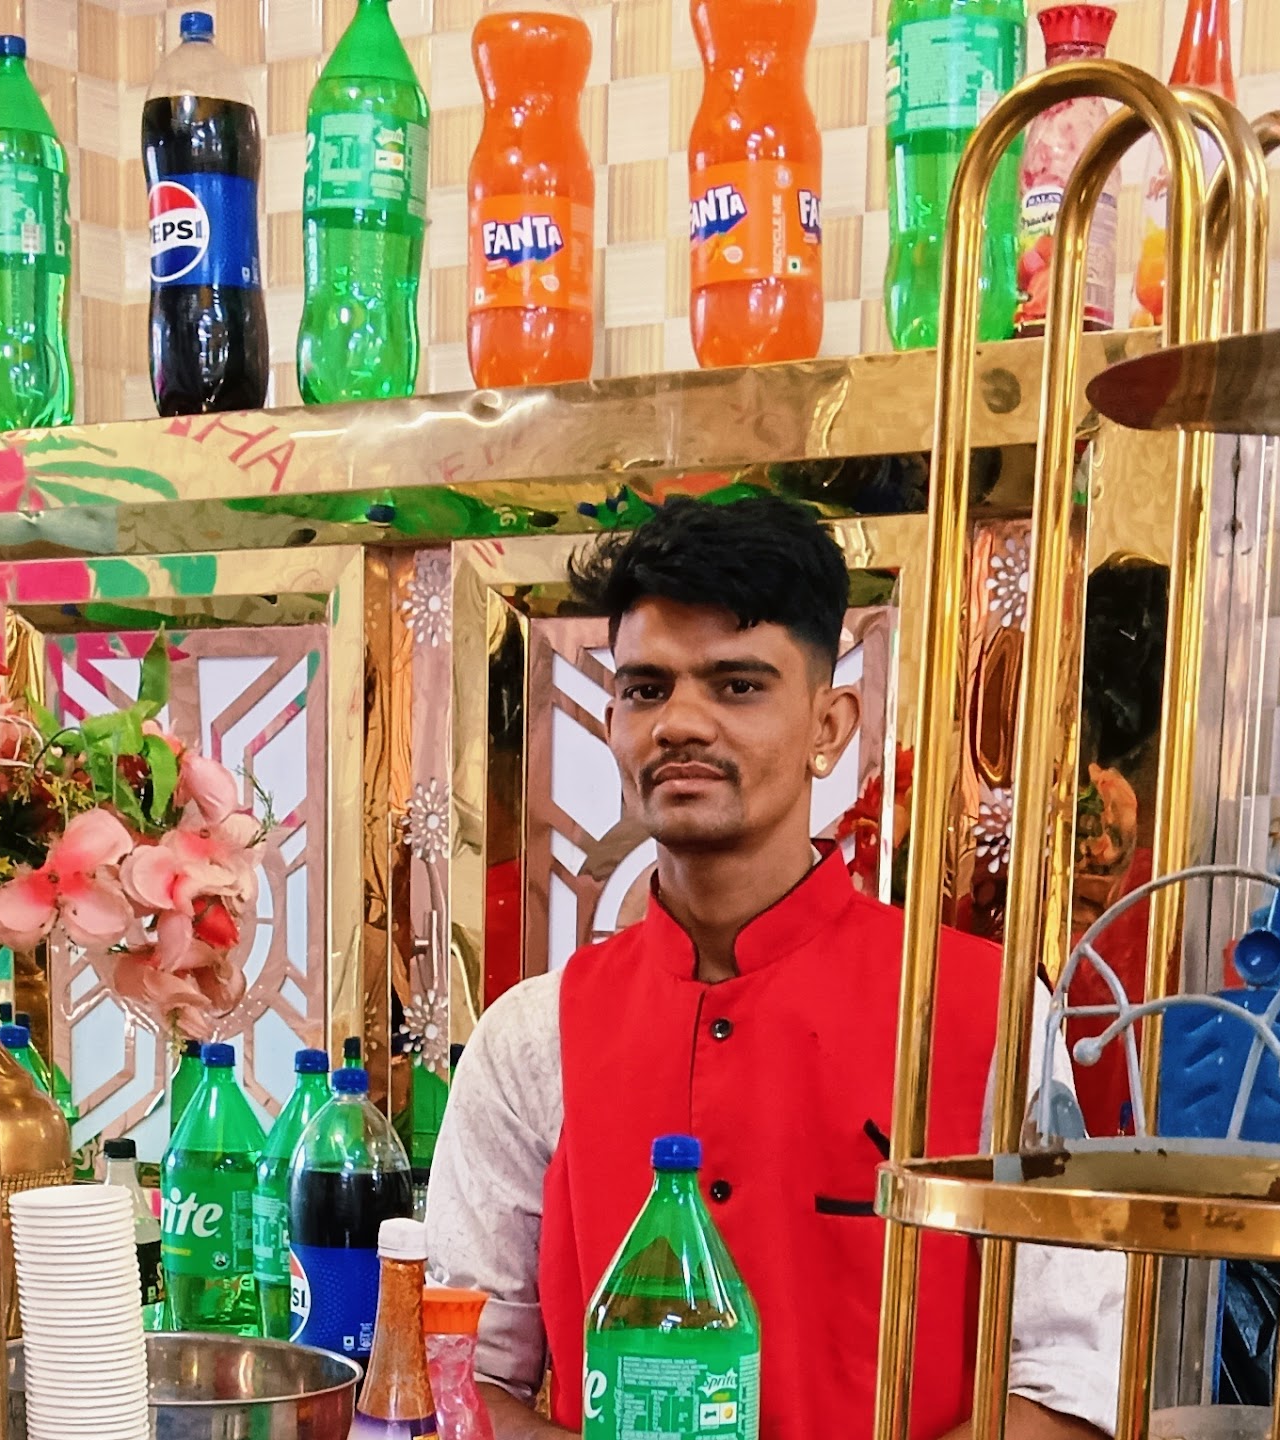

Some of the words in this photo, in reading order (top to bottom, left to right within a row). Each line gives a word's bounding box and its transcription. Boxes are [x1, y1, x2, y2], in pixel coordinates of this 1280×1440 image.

[691, 185, 745, 233] ANTA
[152, 220, 202, 243] EPSI
[483, 216, 562, 254] FANTA
